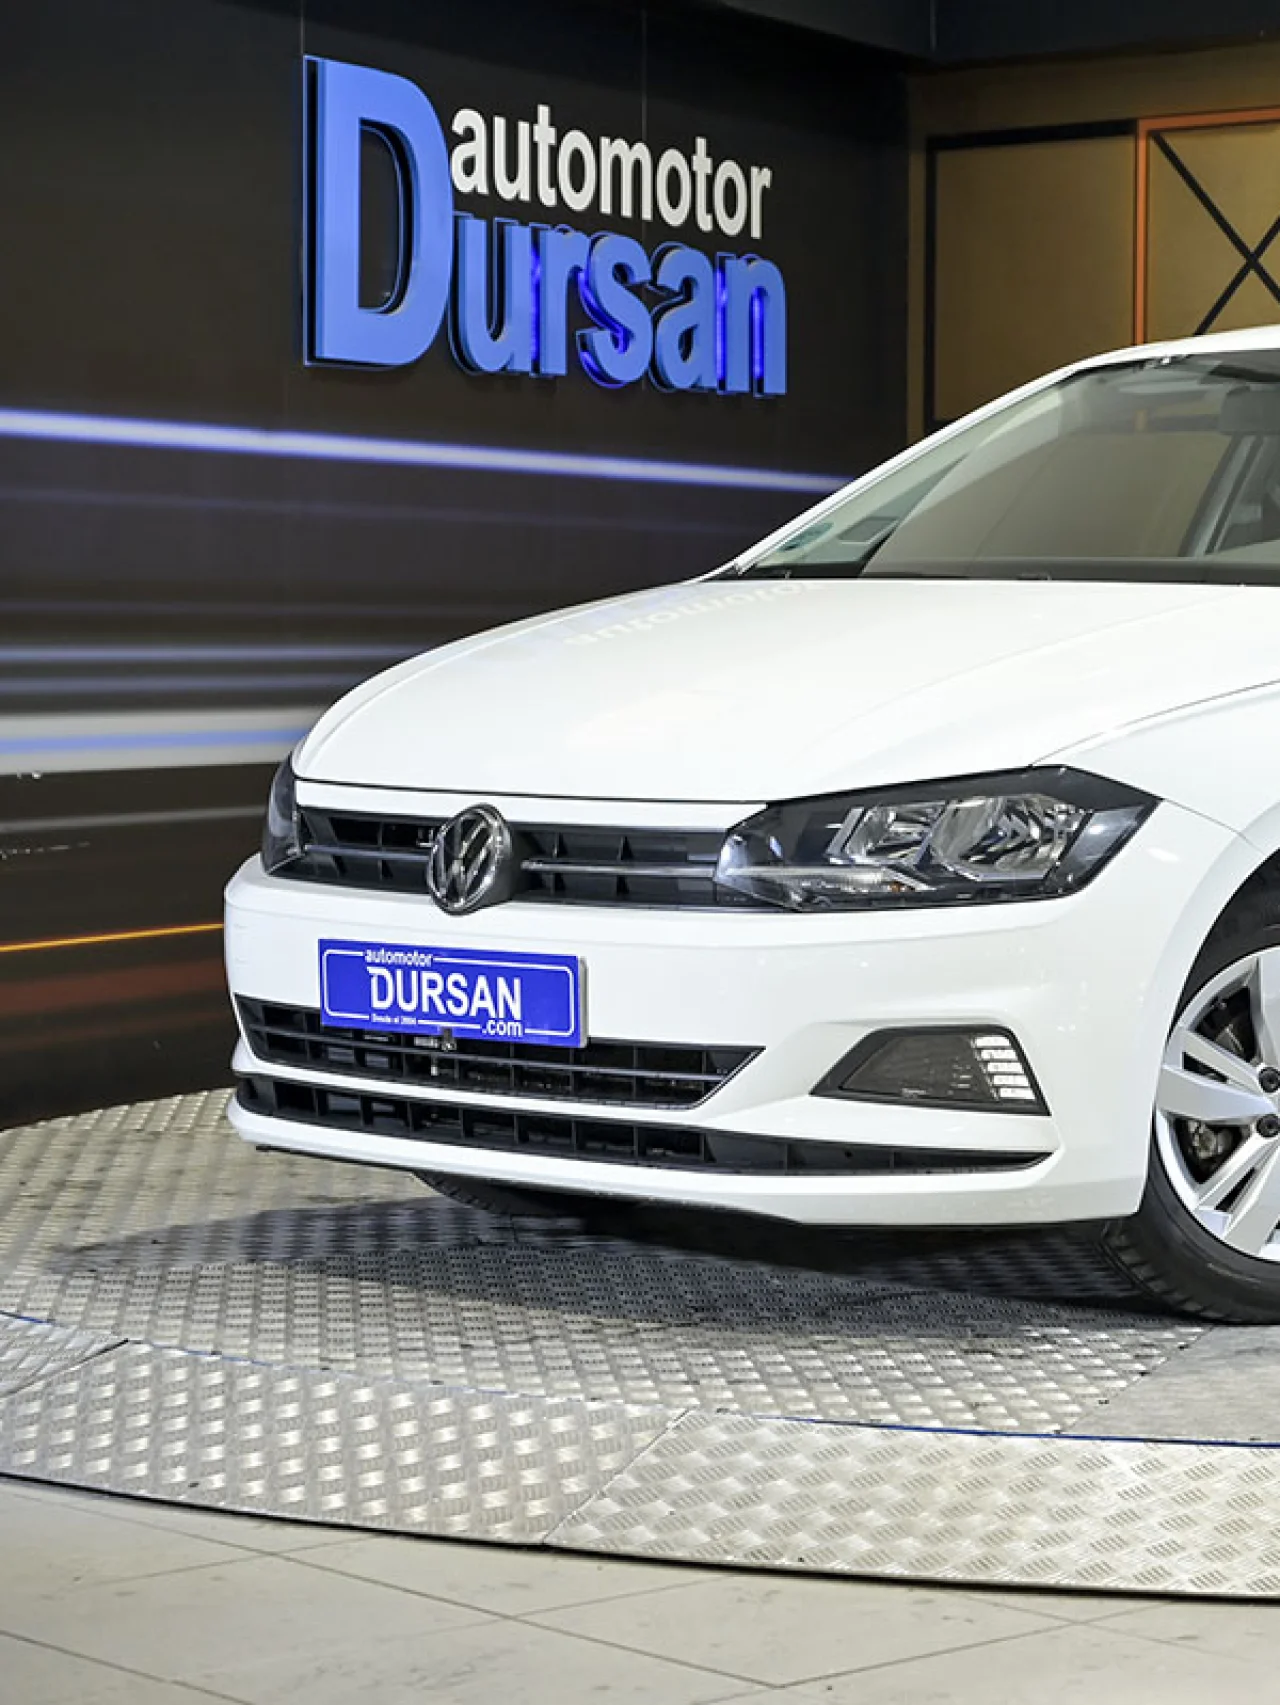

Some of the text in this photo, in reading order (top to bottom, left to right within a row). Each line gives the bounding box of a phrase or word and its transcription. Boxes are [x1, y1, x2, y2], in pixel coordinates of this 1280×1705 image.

[450, 103, 772, 239] automotor
[304, 54, 787, 397] Dursan
[364, 947, 434, 968] automotor
[366, 965, 522, 1021] DURSAN
[481, 1018, 524, 1038] .com
